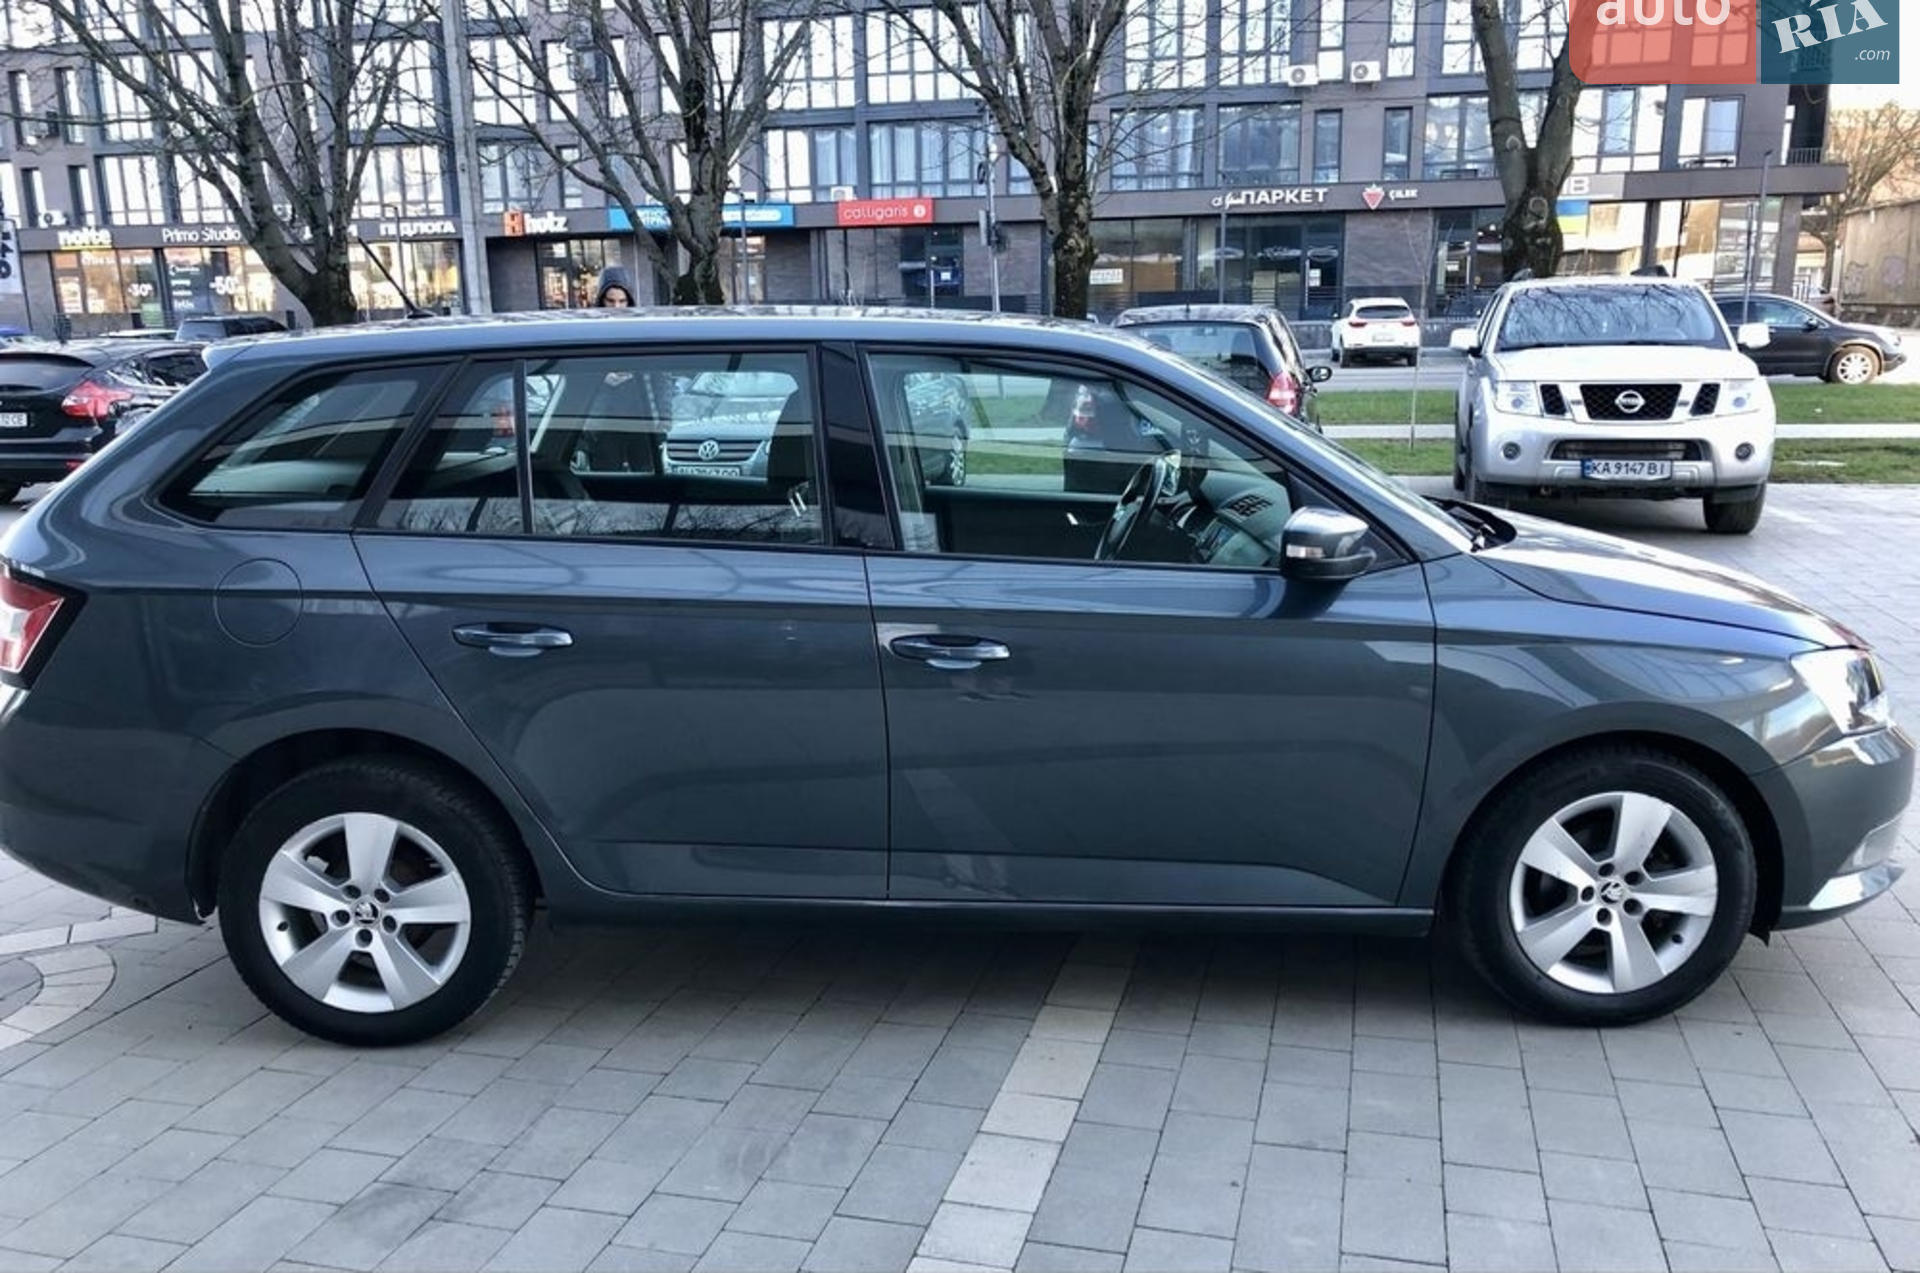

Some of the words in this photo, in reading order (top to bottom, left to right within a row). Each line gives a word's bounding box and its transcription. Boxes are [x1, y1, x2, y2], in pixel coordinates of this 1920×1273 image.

[1241, 187, 1329, 205] ПАРКЕТ
[844, 207, 909, 221] calligaris
[162, 228, 199, 242] Primo
[201, 226, 241, 241] Studio
[1592, 462, 1611, 475] KA
[1614, 462, 1645, 475] 9147
[1647, 462, 1665, 475] BI
